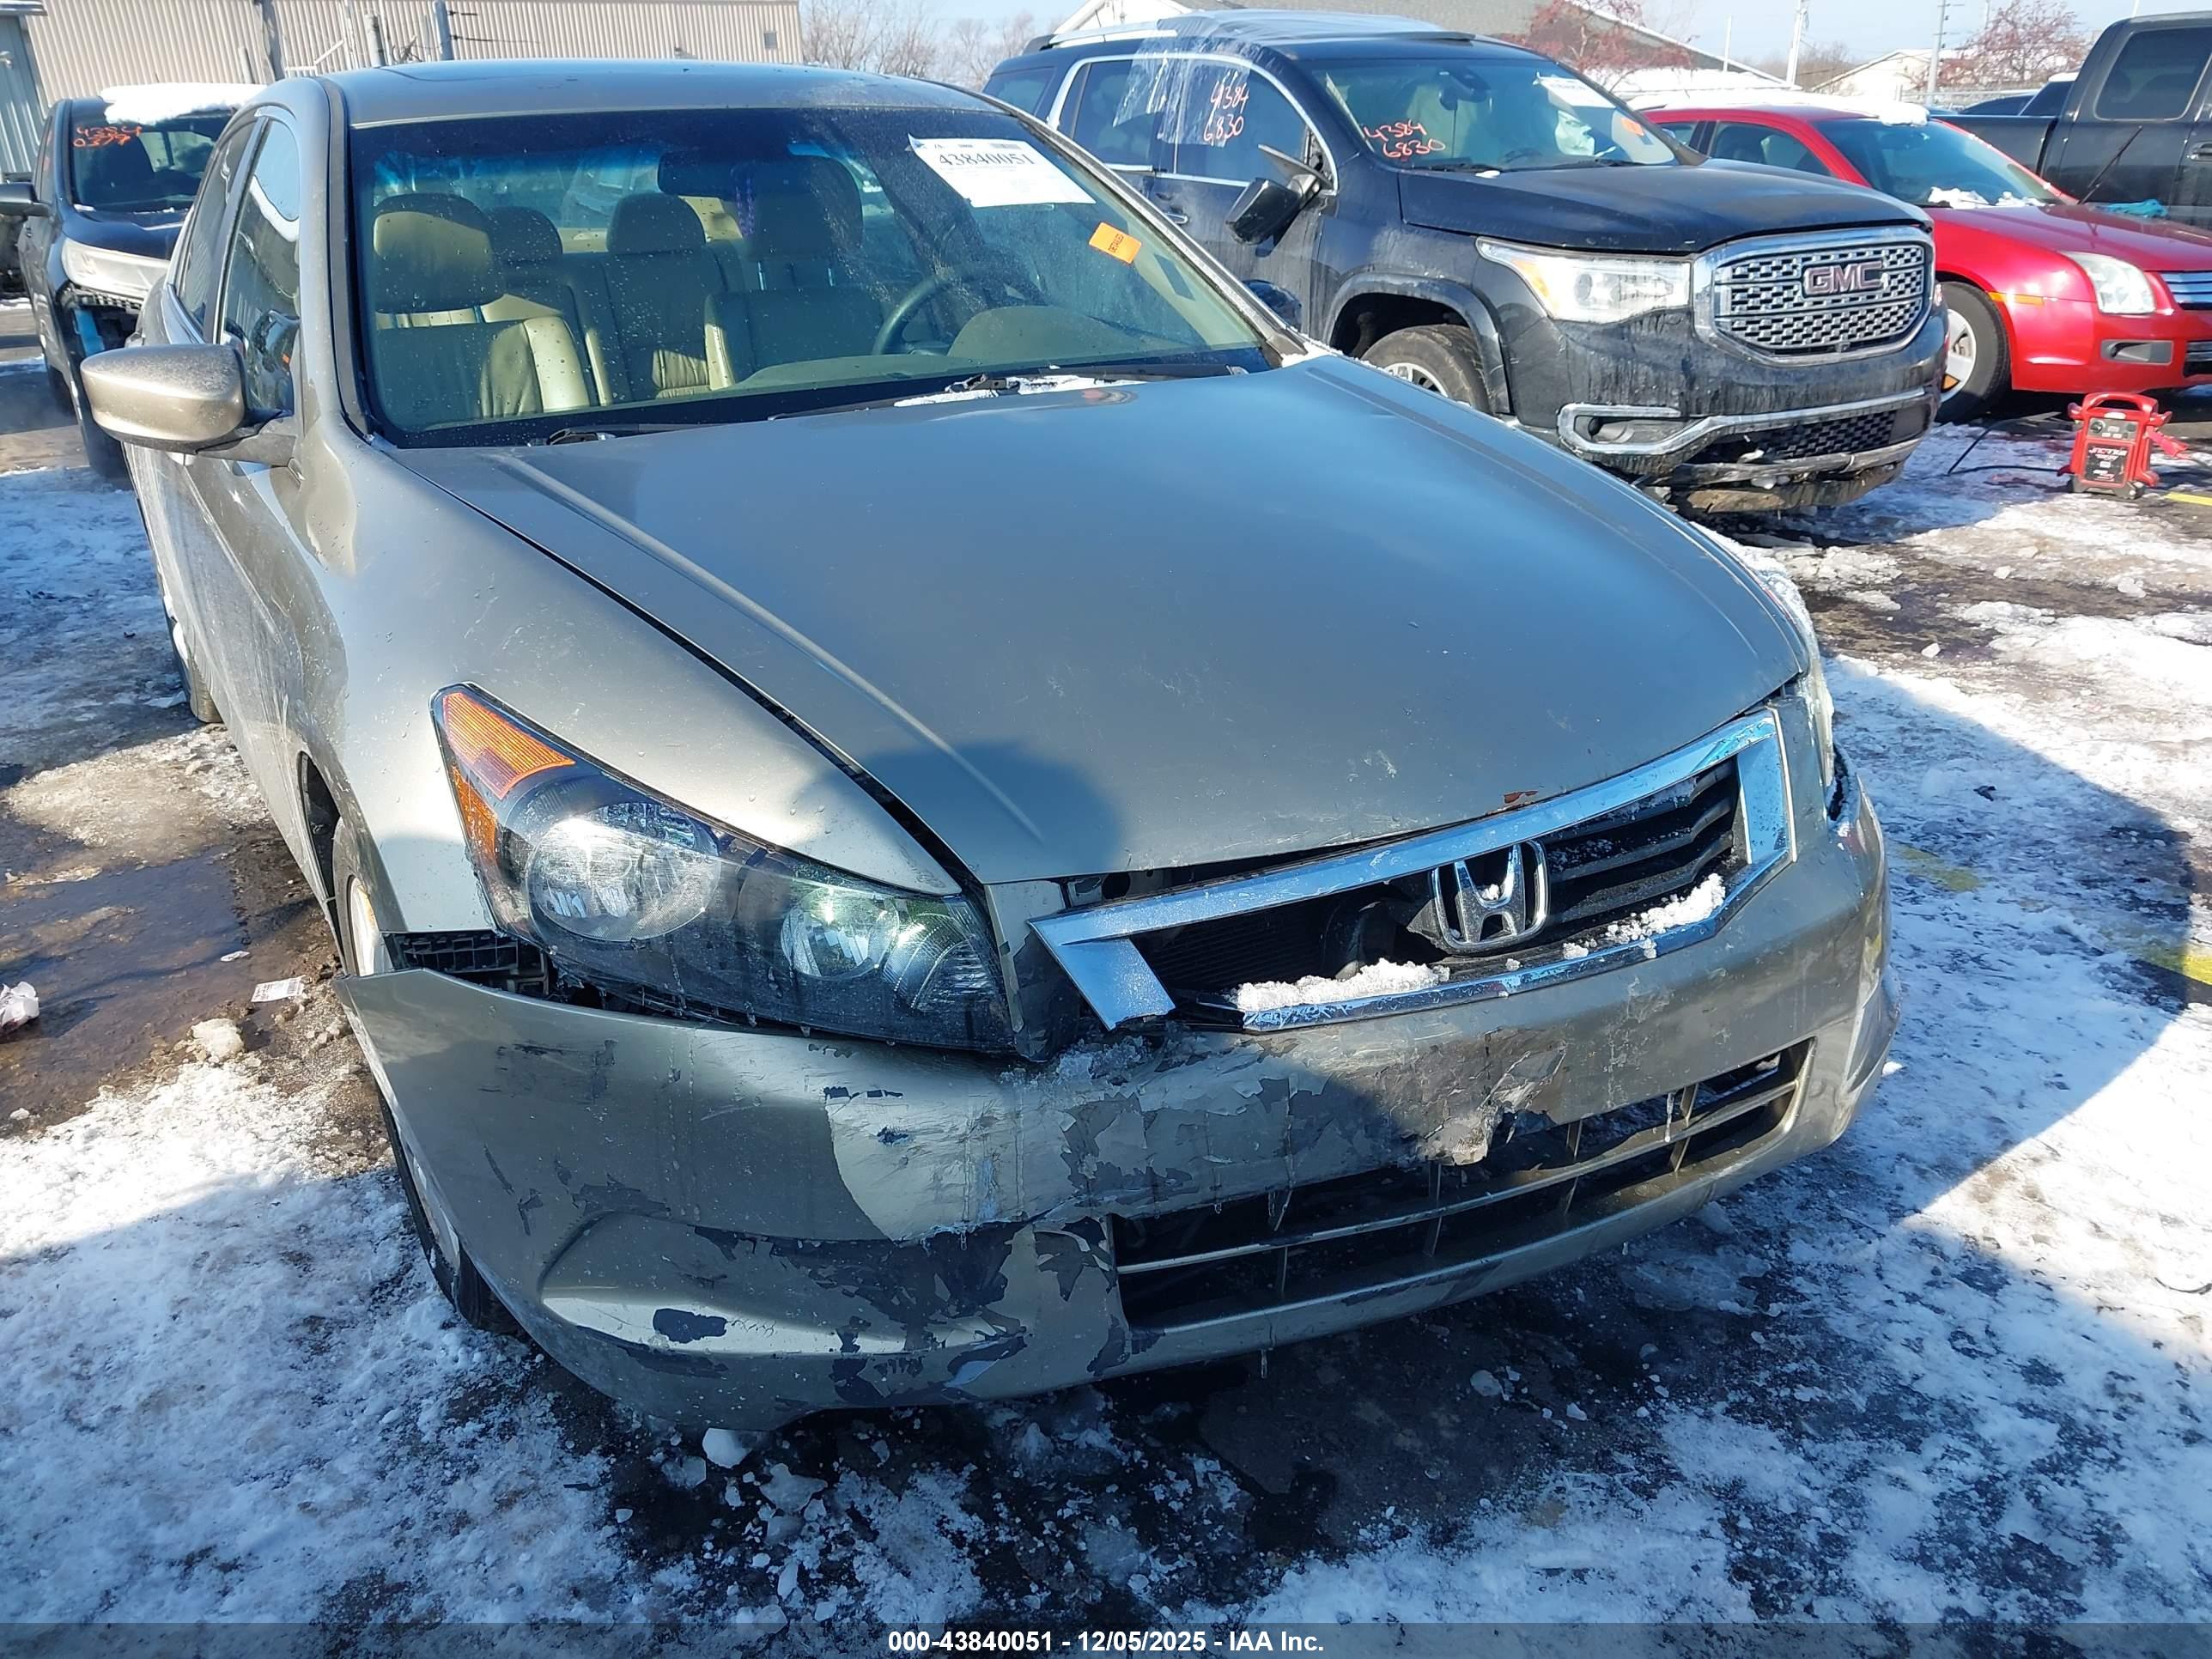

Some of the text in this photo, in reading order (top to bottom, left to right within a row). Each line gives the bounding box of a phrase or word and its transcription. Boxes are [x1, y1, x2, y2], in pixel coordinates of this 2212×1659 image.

[1211, 81, 1249, 114] 4384
[1204, 113, 1244, 142] 6830
[1364, 118, 1427, 142] 4384
[939, 153, 1036, 166] 43840051
[1382, 138, 1446, 158] 6830
[1804, 261, 1882, 295] GMC
